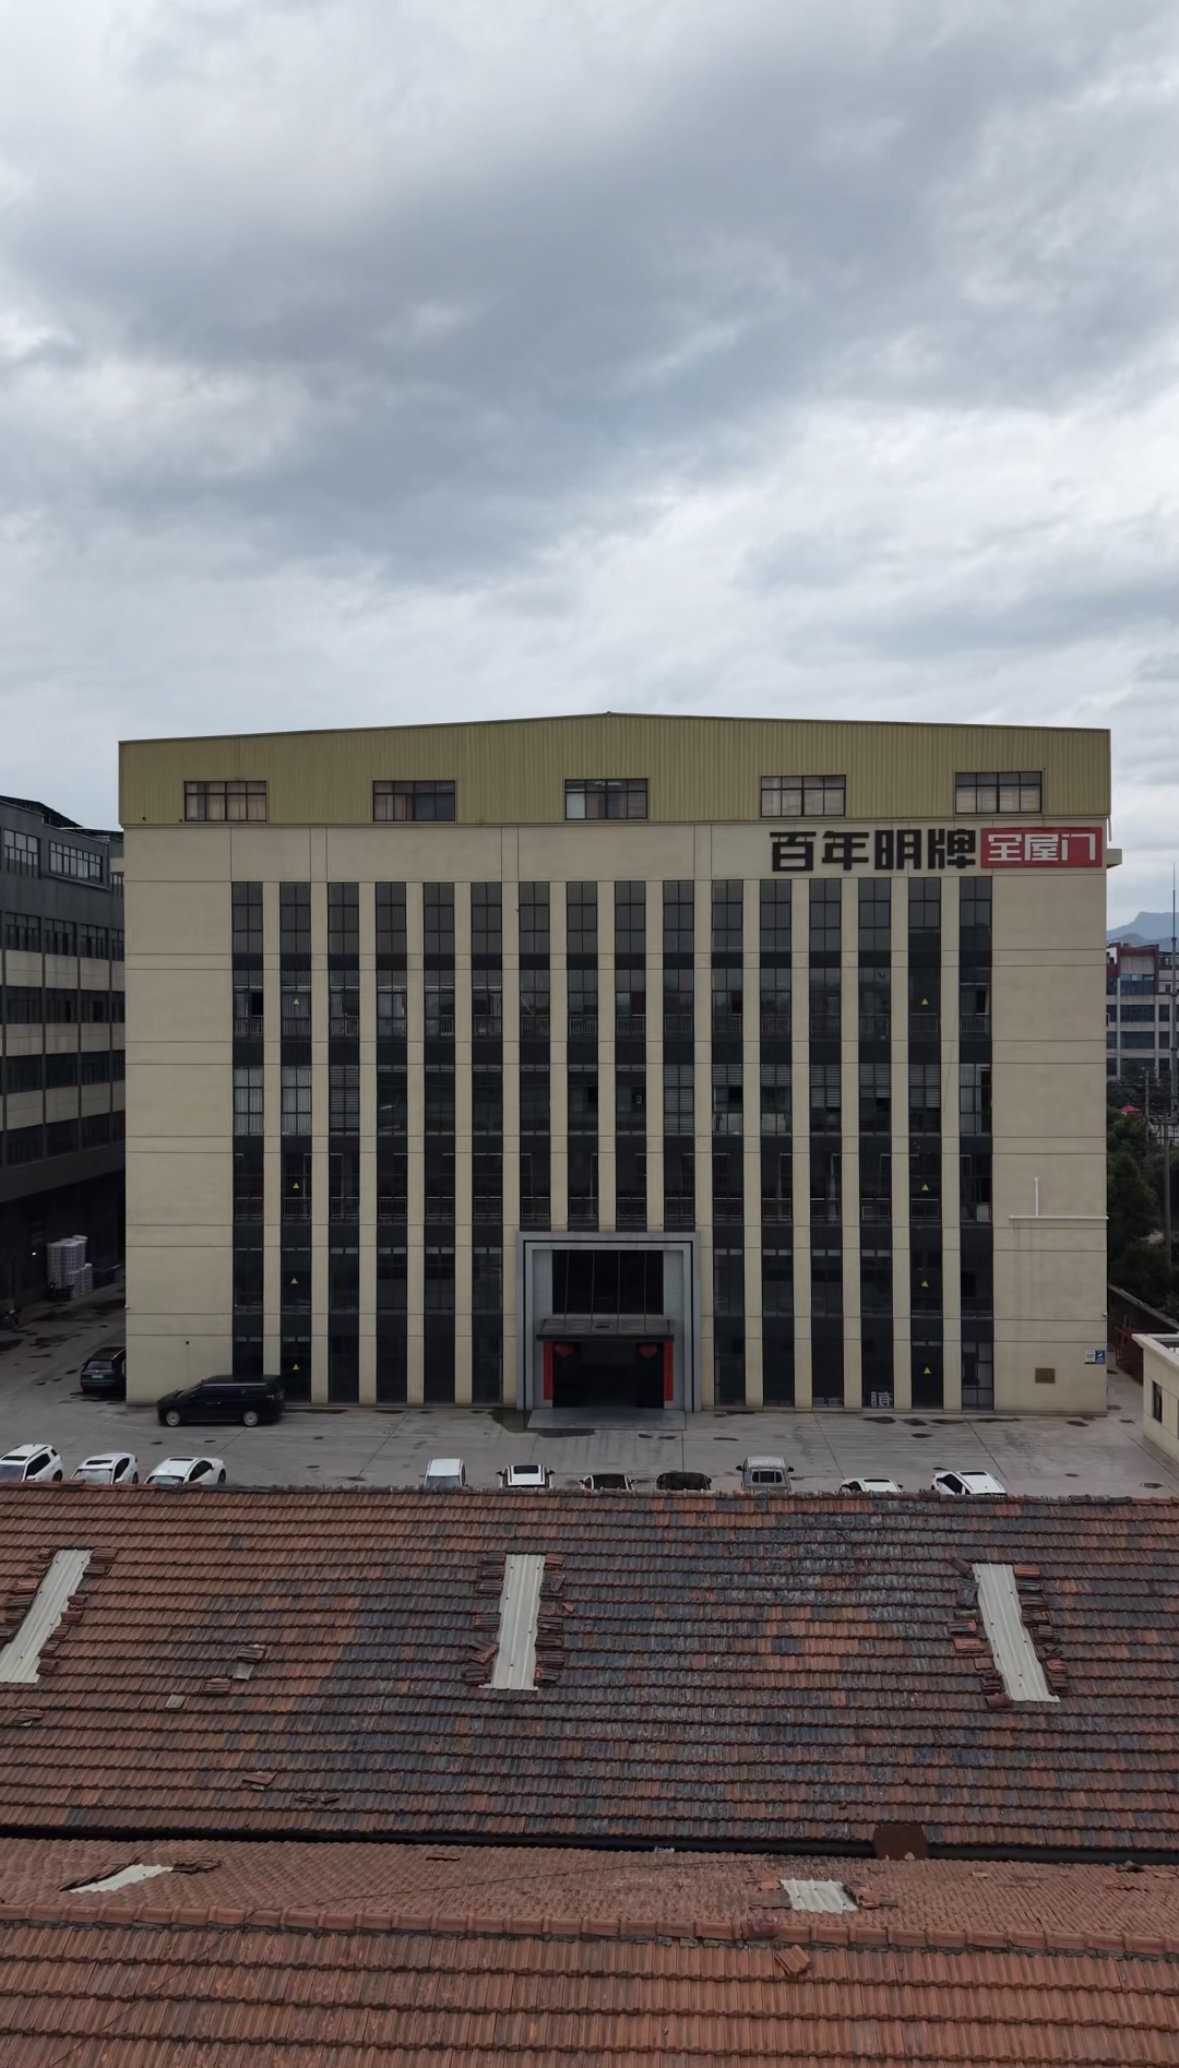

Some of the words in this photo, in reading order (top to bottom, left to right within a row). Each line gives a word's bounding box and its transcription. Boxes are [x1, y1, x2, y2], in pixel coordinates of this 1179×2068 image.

[769, 828, 976, 872] 百年明牌
[987, 833, 1096, 862] 全屋门
